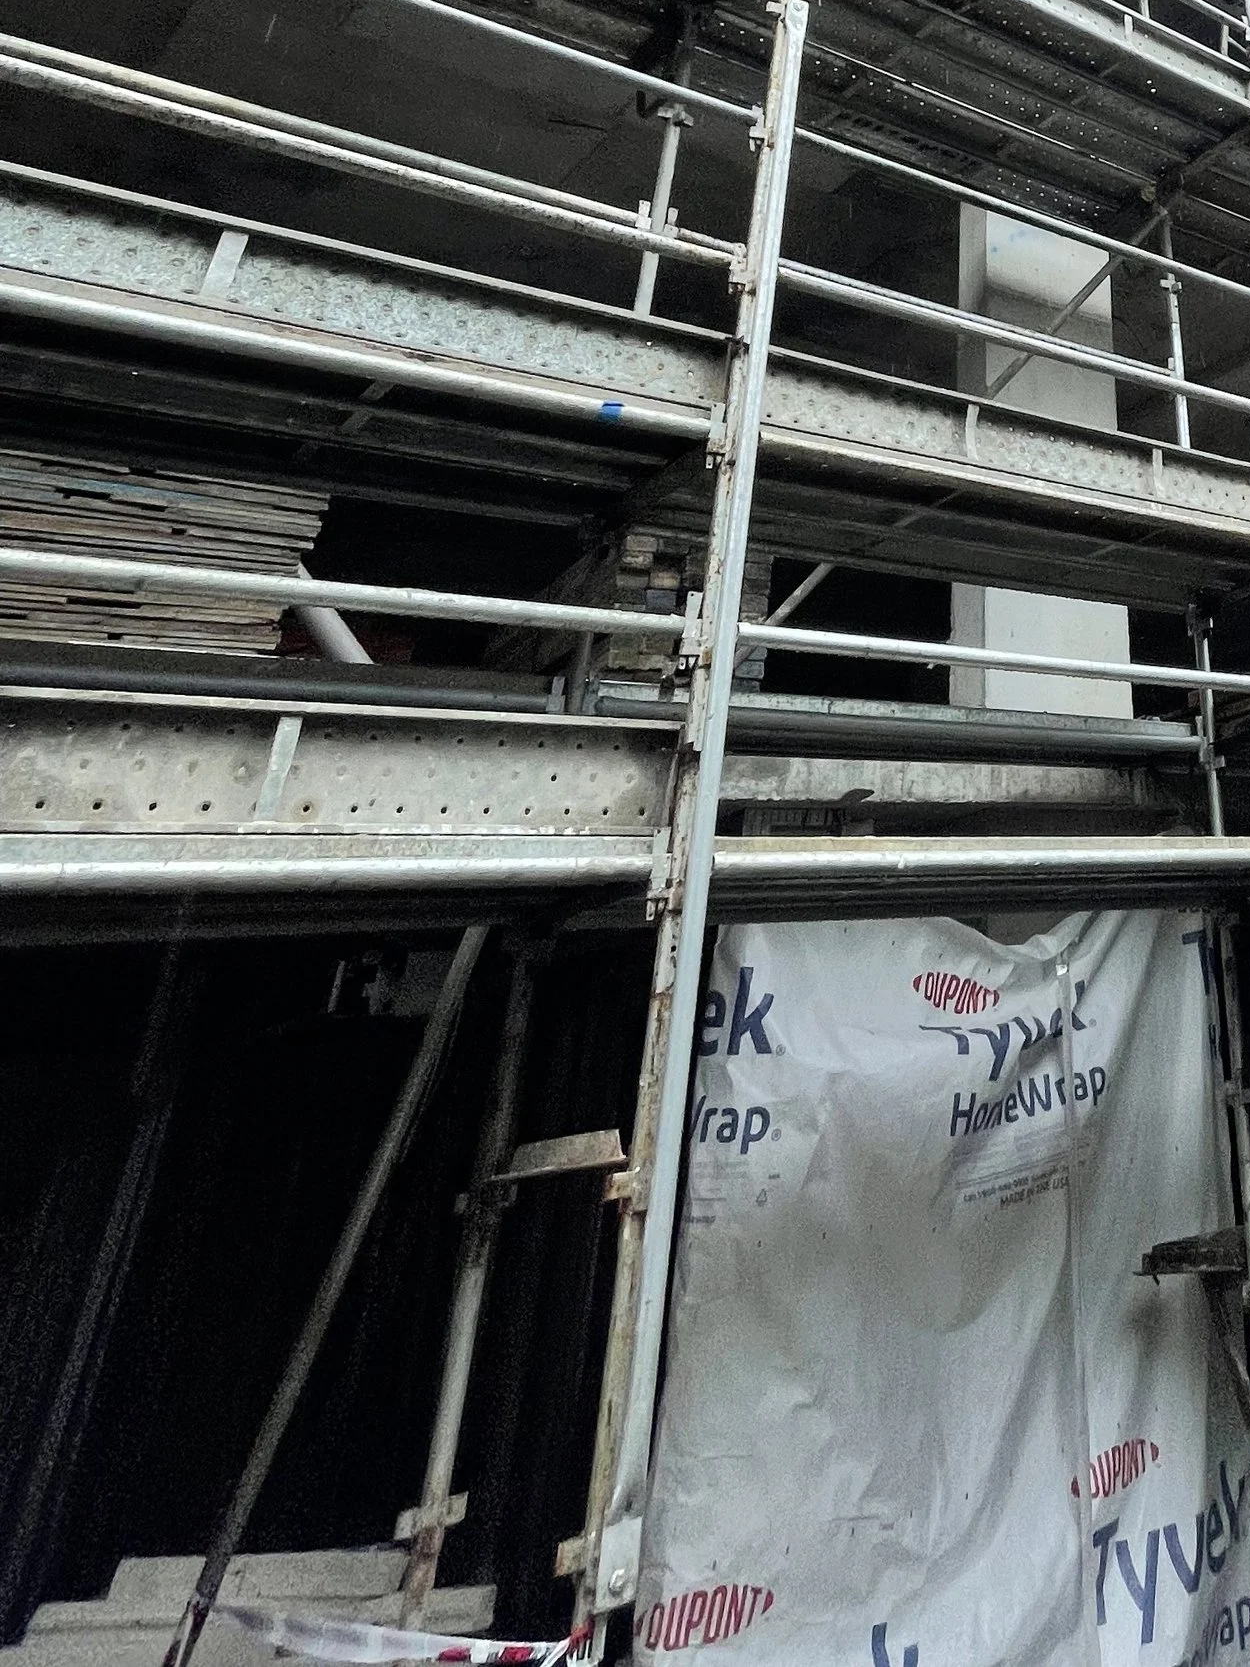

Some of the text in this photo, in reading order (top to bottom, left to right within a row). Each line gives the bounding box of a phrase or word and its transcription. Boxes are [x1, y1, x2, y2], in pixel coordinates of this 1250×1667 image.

[924, 972, 992, 1014] DUPONT
[1090, 1438, 1147, 1499] DUPONT
[644, 1584, 763, 1651] DUPONT
